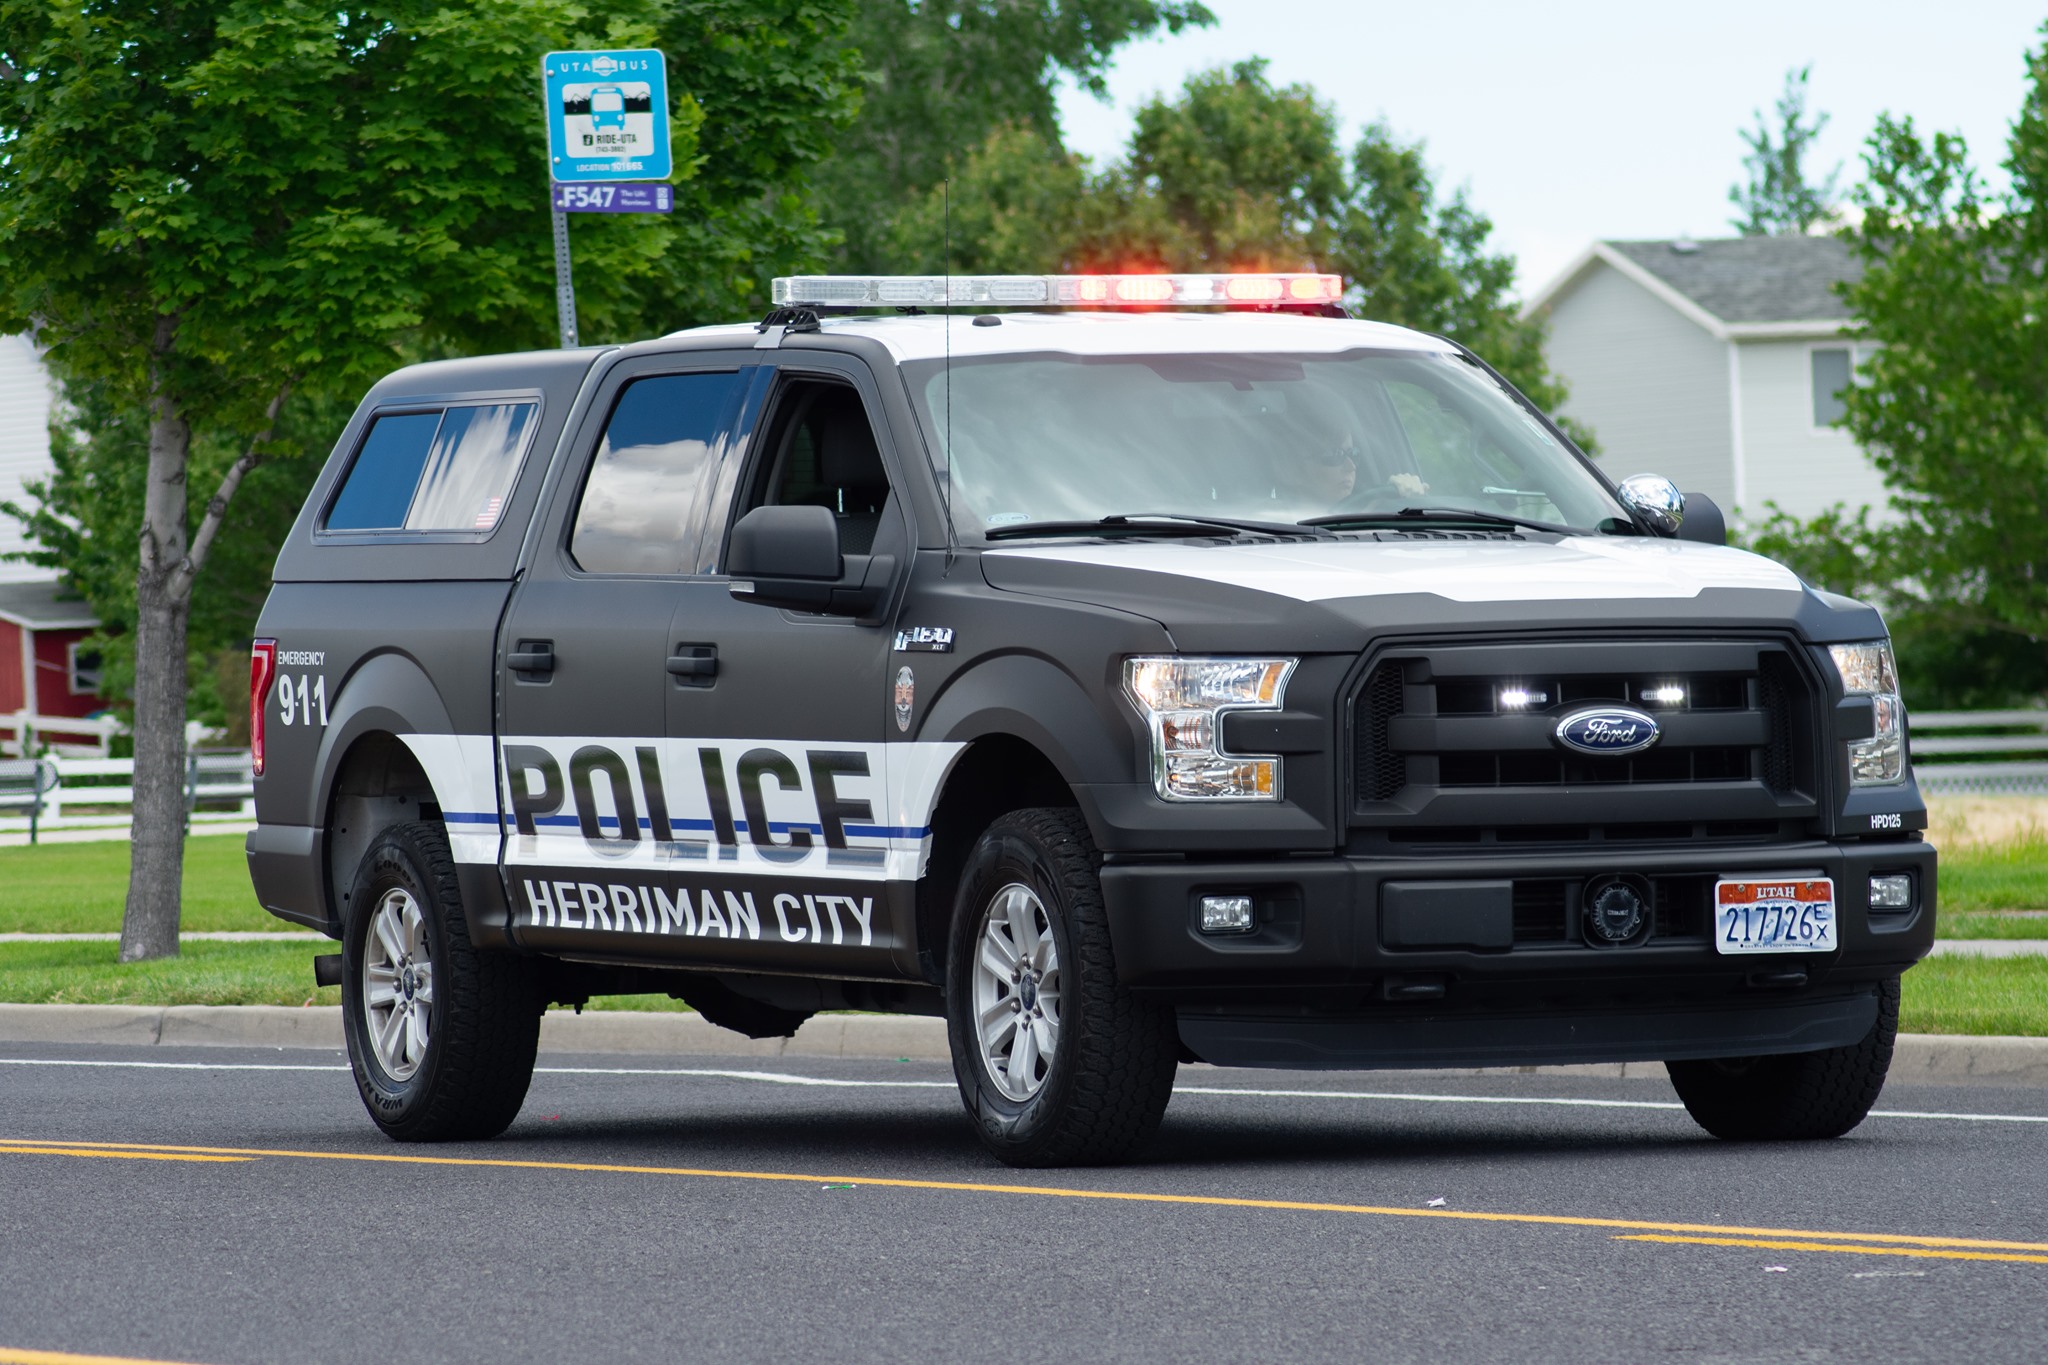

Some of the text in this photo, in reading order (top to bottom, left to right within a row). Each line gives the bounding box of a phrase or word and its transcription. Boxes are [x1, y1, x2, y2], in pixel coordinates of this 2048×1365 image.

[560, 59, 648, 72] UTA BUS
[596, 134, 637, 144] RIDE-UTA
[563, 186, 616, 208] F547
[278, 651, 326, 666] EMERGENCY
[1583, 718, 1637, 744] Ford
[502, 744, 888, 870] POLICE
[1870, 813, 1902, 829] HPD125
[1756, 886, 1796, 899] UTAH
[523, 879, 873, 947] HERRIMAN CITY
[1726, 905, 1813, 942] 217726
